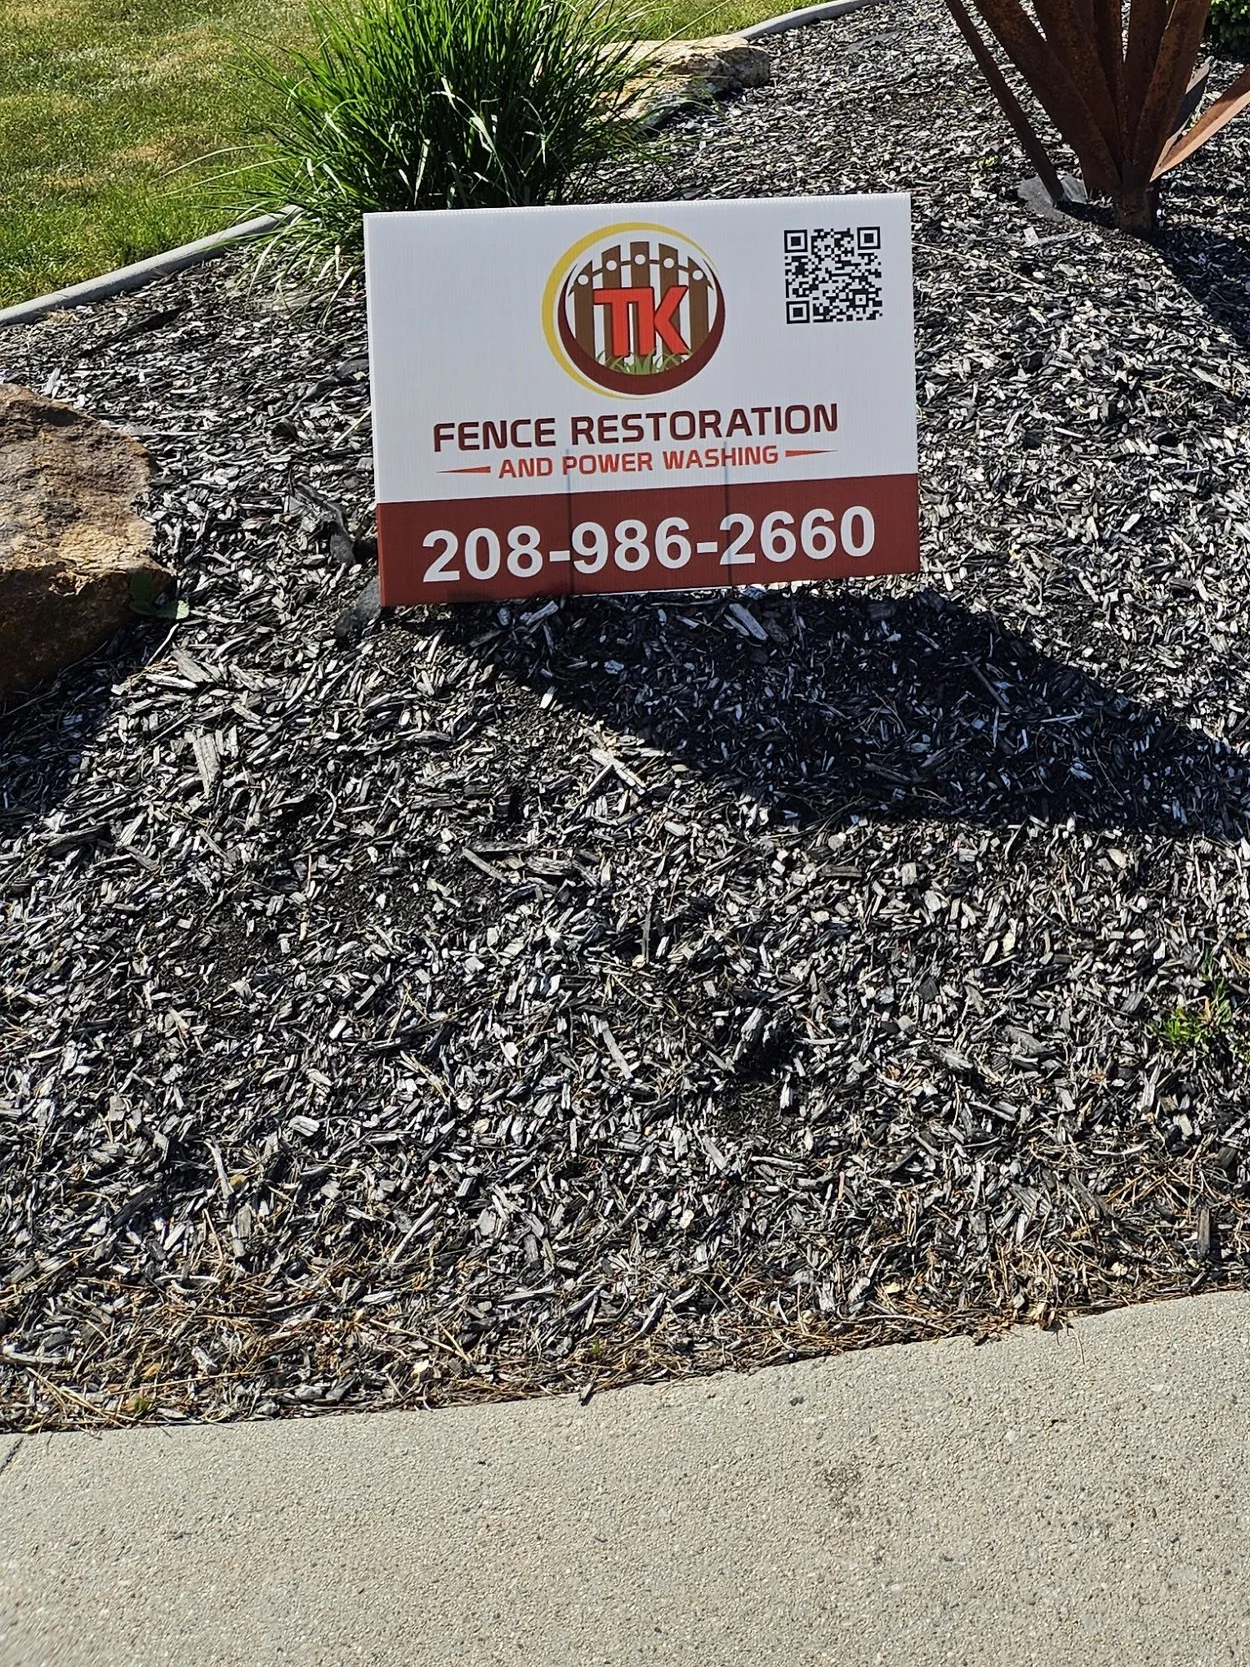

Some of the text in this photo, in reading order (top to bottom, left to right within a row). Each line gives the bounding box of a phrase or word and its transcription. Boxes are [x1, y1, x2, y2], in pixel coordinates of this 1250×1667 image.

[593, 286, 690, 356] TK
[434, 404, 838, 452] FENCE RESTORATION
[499, 446, 778, 478] AND POWER WASHING
[423, 506, 875, 582] 208-986-2660
